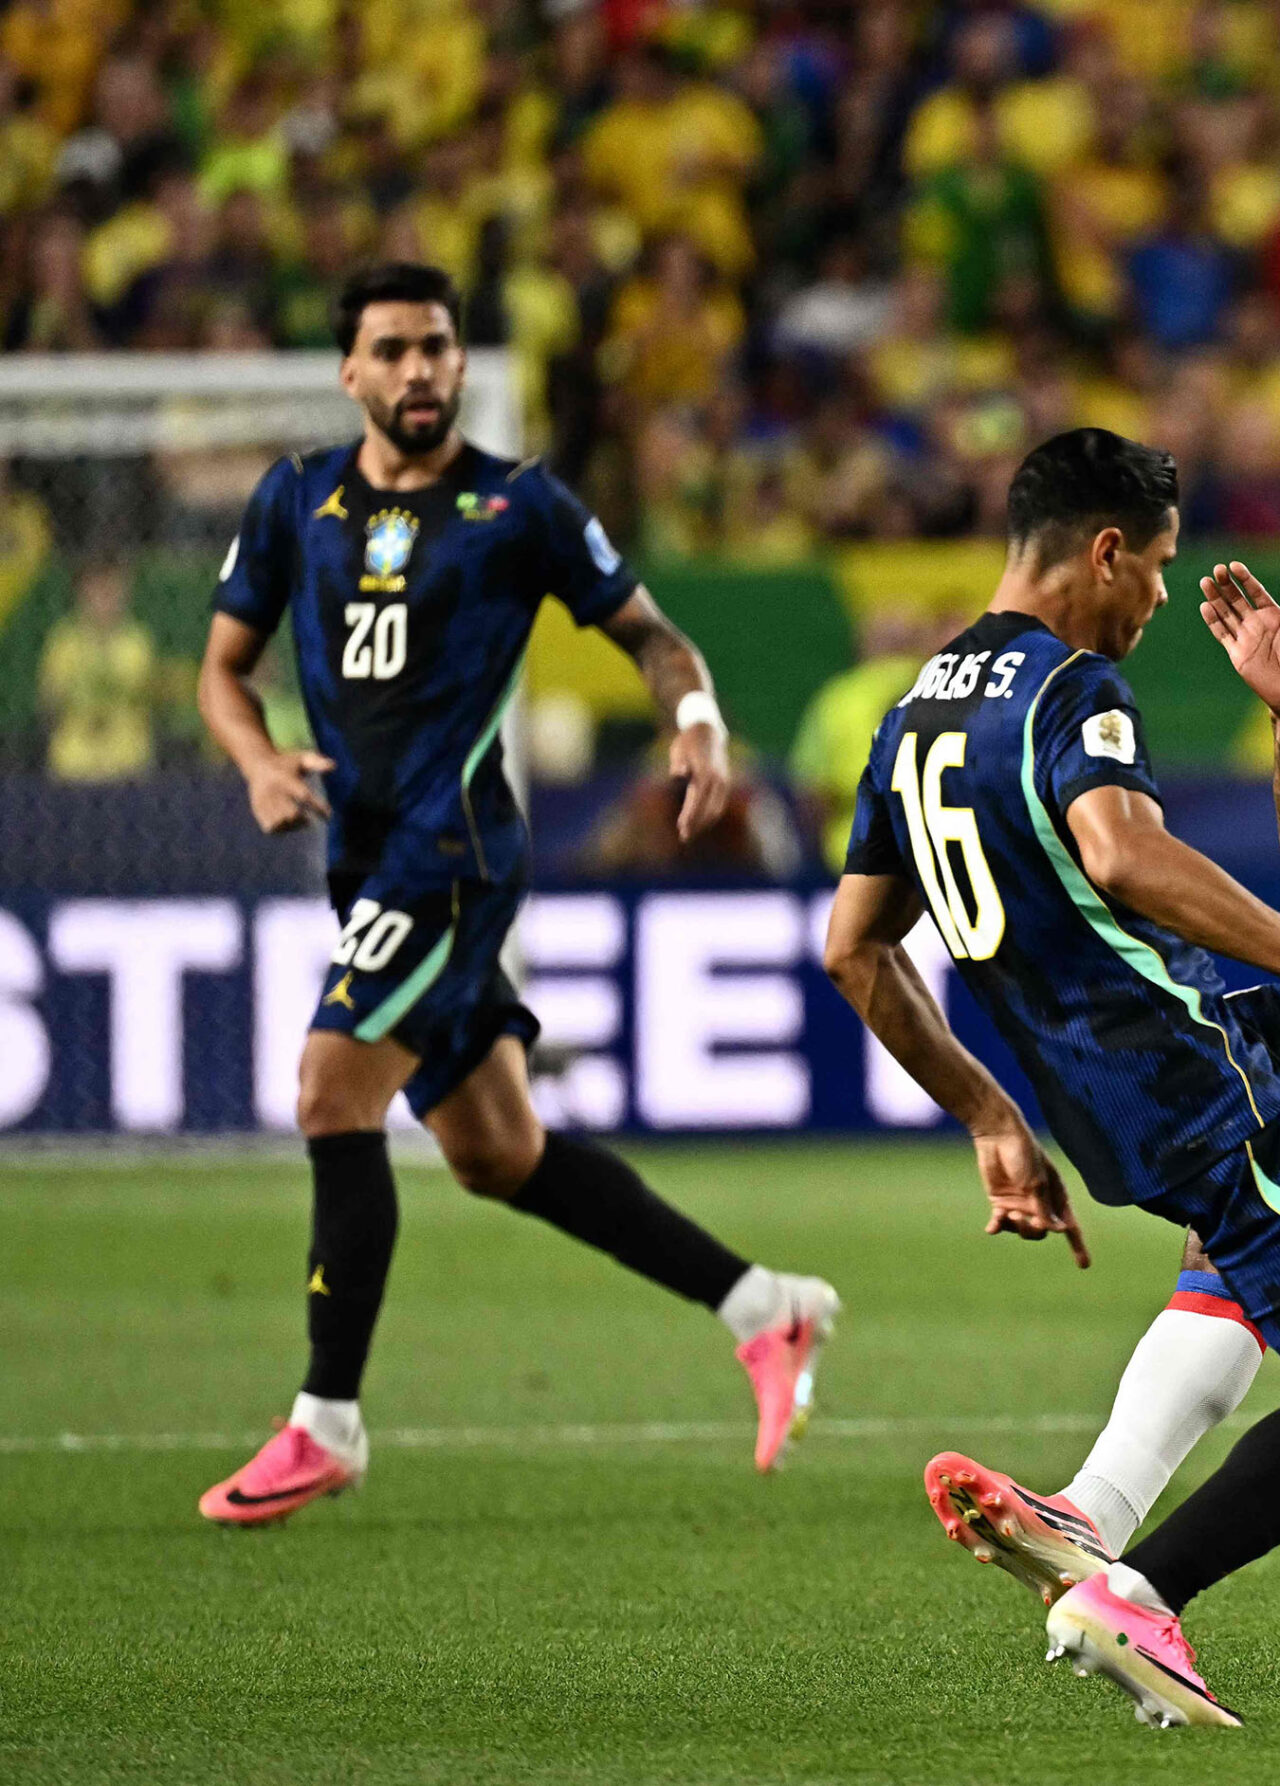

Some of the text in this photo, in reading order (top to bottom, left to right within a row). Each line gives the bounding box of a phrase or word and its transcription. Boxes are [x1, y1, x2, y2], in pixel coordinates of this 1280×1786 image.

[342, 602, 407, 679] 20
[897, 650, 1026, 708] GLAS S.
[891, 732, 1006, 961] 16
[330, 898, 414, 972] 20
